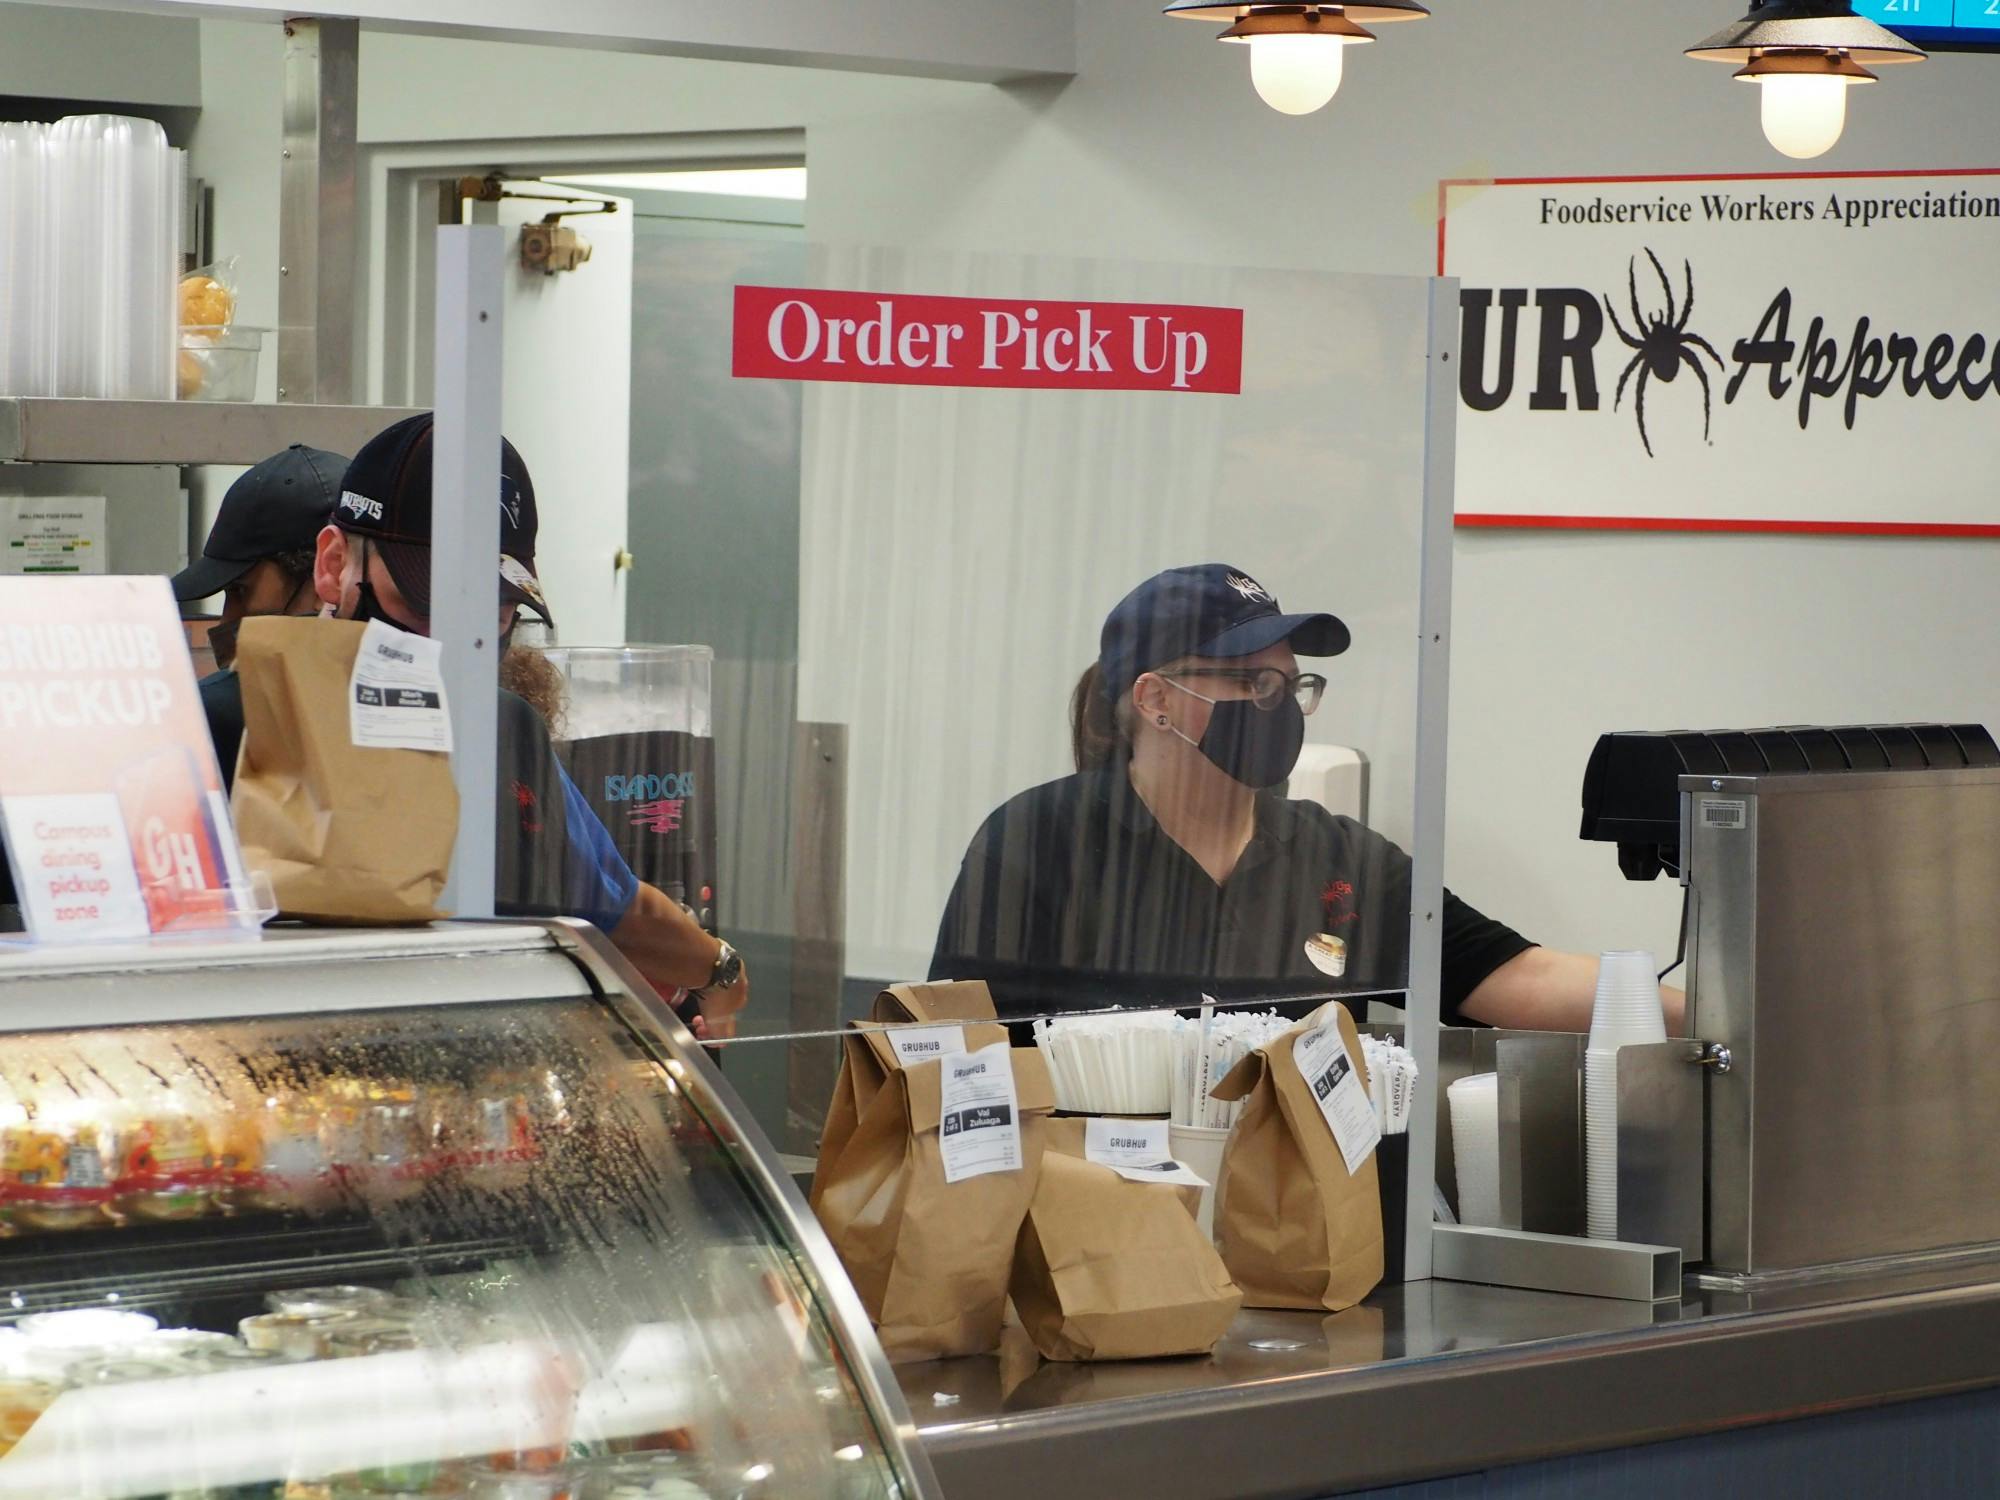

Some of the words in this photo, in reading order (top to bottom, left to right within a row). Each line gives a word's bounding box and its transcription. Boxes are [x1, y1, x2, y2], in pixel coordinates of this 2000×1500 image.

[1540, 196, 1692, 225] Foodservice
[1700, 193, 1815, 222] Workers
[1823, 190, 2000, 228] Appreciation
[767, 299, 964, 369] Order
[978, 307, 1113, 373] Pick
[1128, 315, 1209, 388] Up
[1460, 288, 1603, 412] UR
[0, 678, 173, 728] PICKUP
[34, 821, 112, 843] Campus
[41, 848, 103, 871] dining
[49, 875, 111, 903] pickup
[55, 904, 99, 921] zone
[901, 1041, 940, 1053] GRUBHUB
[976, 1108, 990, 1118] Val
[1110, 1137, 1147, 1149] GRUBHUB
